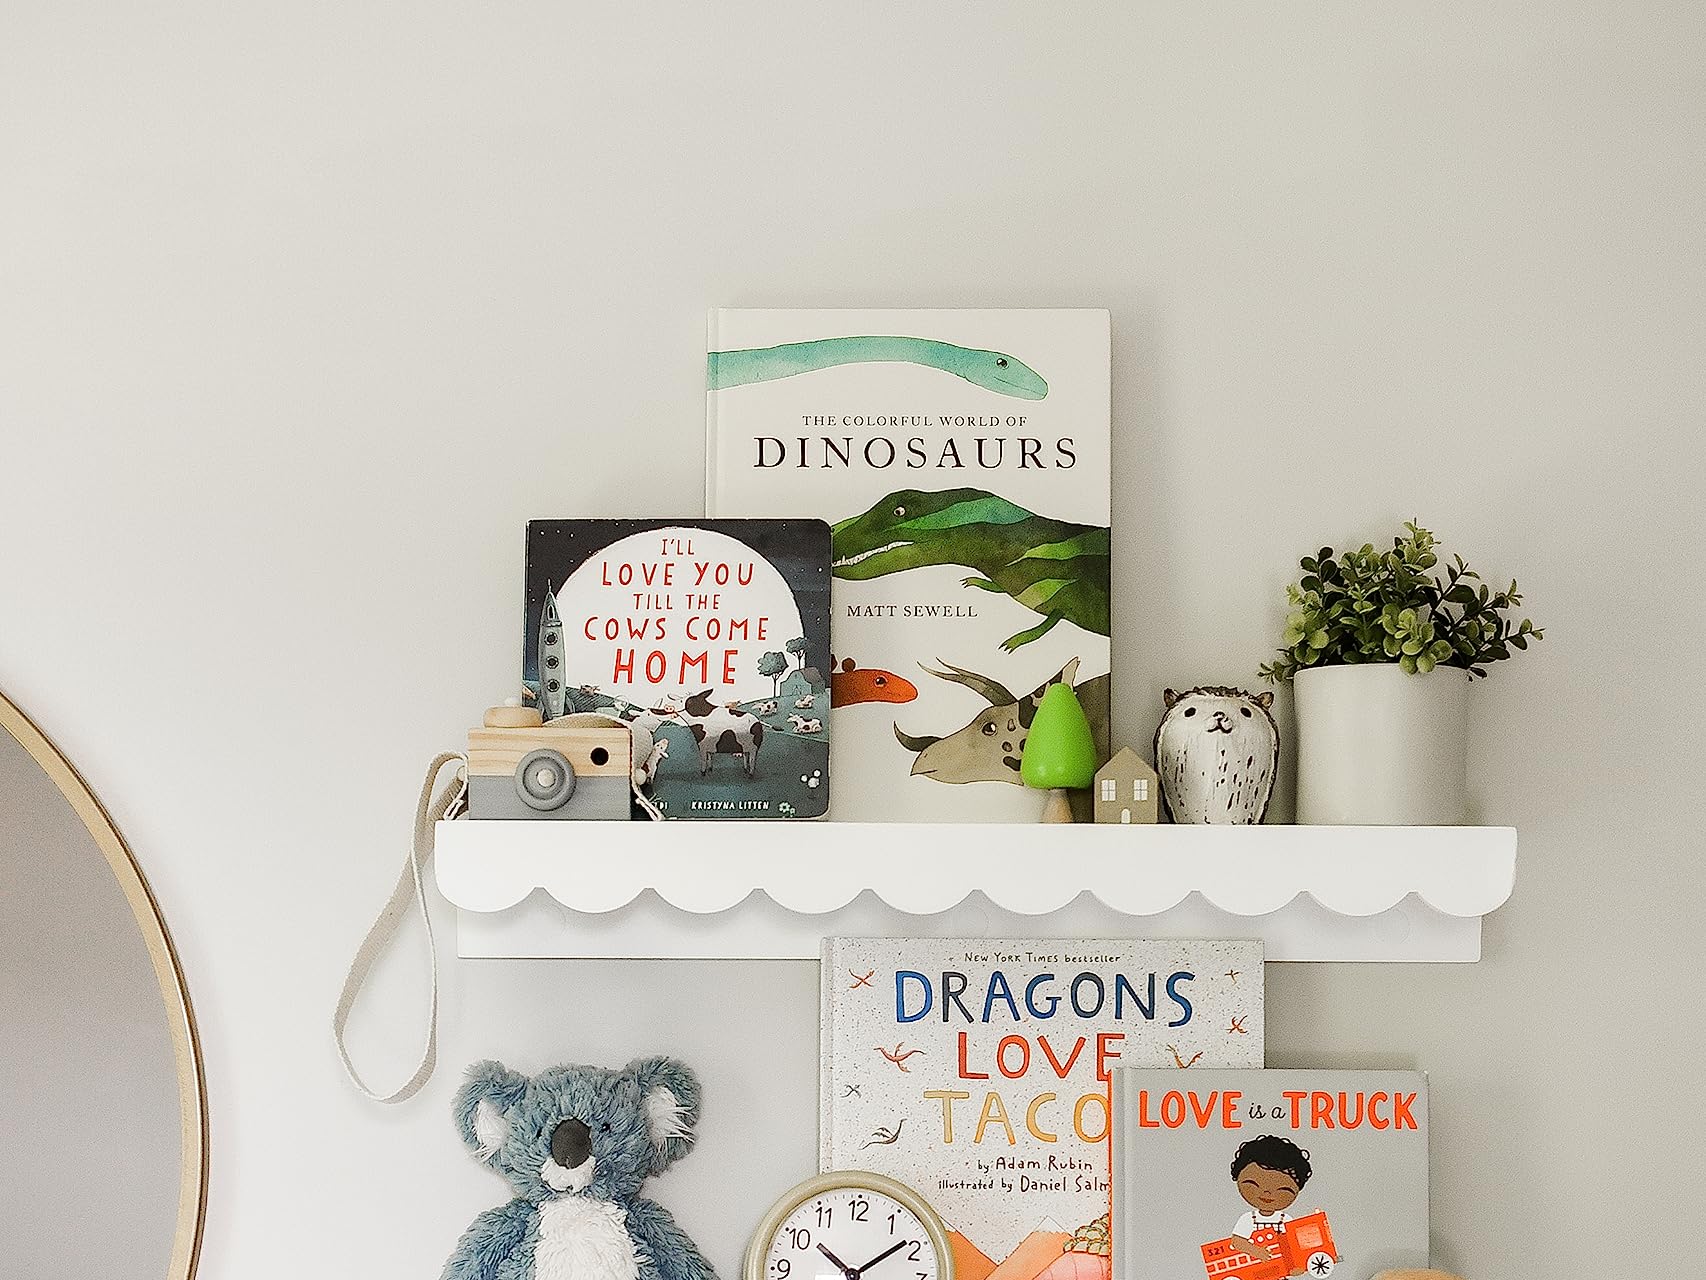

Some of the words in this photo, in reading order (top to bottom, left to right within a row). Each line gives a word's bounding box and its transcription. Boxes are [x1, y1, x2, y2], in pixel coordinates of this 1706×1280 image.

[801, 415, 837, 427] THE
[842, 415, 934, 427] COLORFUL
[938, 415, 1001, 427] WORLD
[1005, 415, 1029, 427] OF
[753, 437, 1077, 469] DINOSAURS
[661, 538, 696, 556] I'LL
[602, 562, 675, 587] LOVE
[694, 562, 754, 586] YOU
[633, 593, 674, 610] TILL
[685, 593, 721, 610] THE
[845, 604, 898, 620] MATT
[902, 604, 980, 620] SEWELL
[584, 617, 667, 641] COWS
[686, 617, 770, 641] COME
[612, 648, 739, 685] HOME
[690, 800, 735, 811] KRISTYNA
[738, 800, 770, 811] LITTEN
[1064, 953, 1122, 963] bestseller
[895, 970, 1195, 1028] DRAGONS
[957, 1031, 1126, 1082] LOVE
[1138, 1090, 1242, 1129] LOVE
[1248, 1103, 1267, 1120] is
[1271, 1104, 1286, 1120] a
[1282, 1091, 1418, 1129] TRUCK
[977, 1158, 990, 1175] by
[995, 1155, 1041, 1171] Adam
[1047, 1154, 1094, 1171] Rubin
[937, 1178, 995, 1190] illustrated
[1000, 1176, 1014, 1193] by
[1019, 1173, 1068, 1193] Daniel
[814, 1206, 834, 1229] 11
[848, 1199, 870, 1222] 12
[887, 1214, 896, 1235] 1
[788, 1228, 811, 1250] 10
[907, 1240, 921, 1262] 2
[776, 1258, 791, 1280] 9
